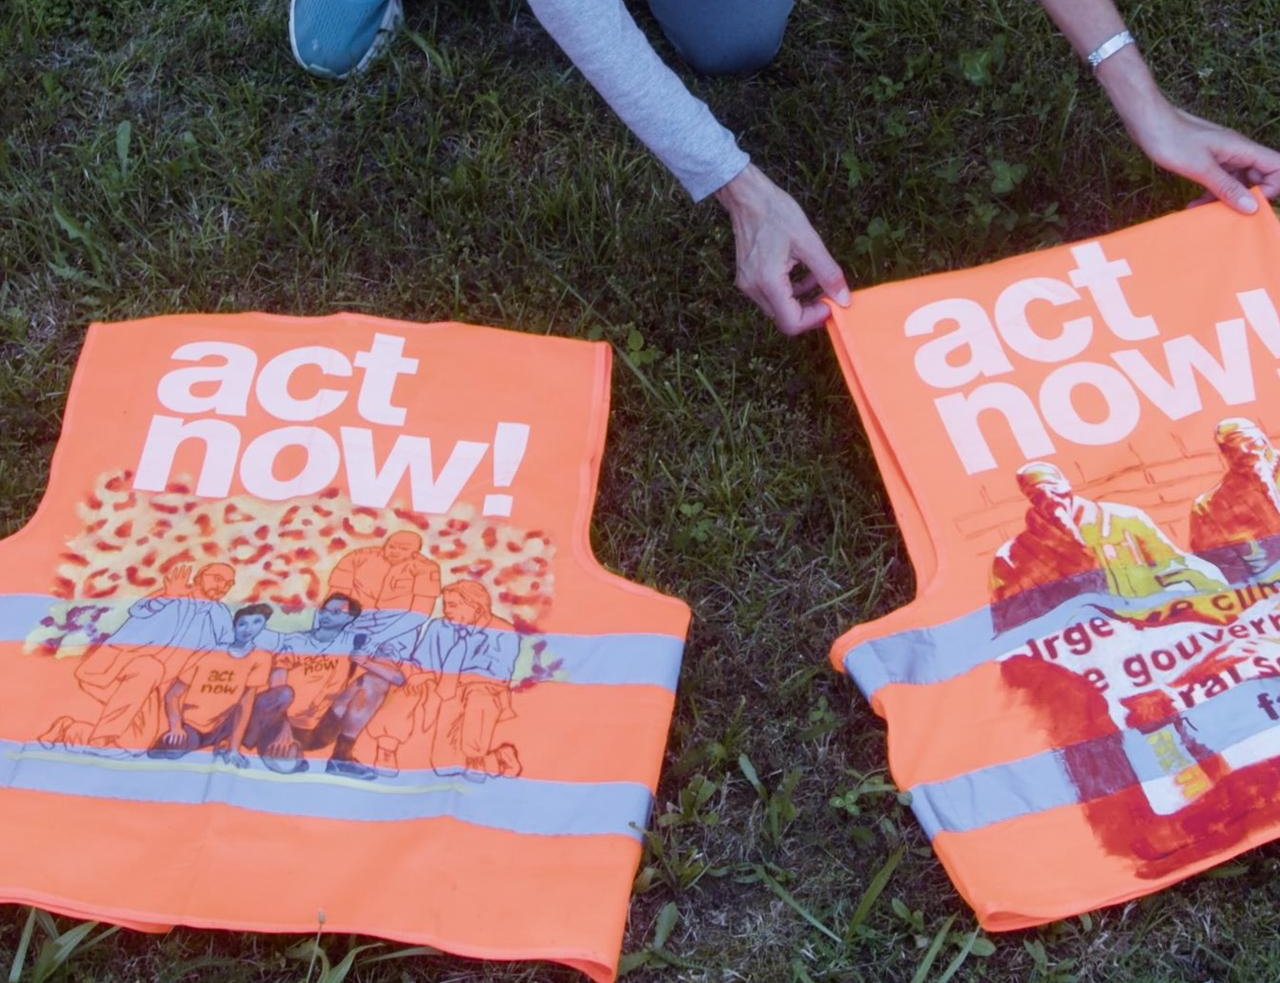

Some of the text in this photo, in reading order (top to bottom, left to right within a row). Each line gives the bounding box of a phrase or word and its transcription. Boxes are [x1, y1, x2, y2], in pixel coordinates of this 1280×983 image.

[903, 241, 1154, 390] act
[156, 333, 419, 426] act
[132, 414, 531, 518] now!
[200, 684, 239, 695] now
[207, 669, 235, 682] act
